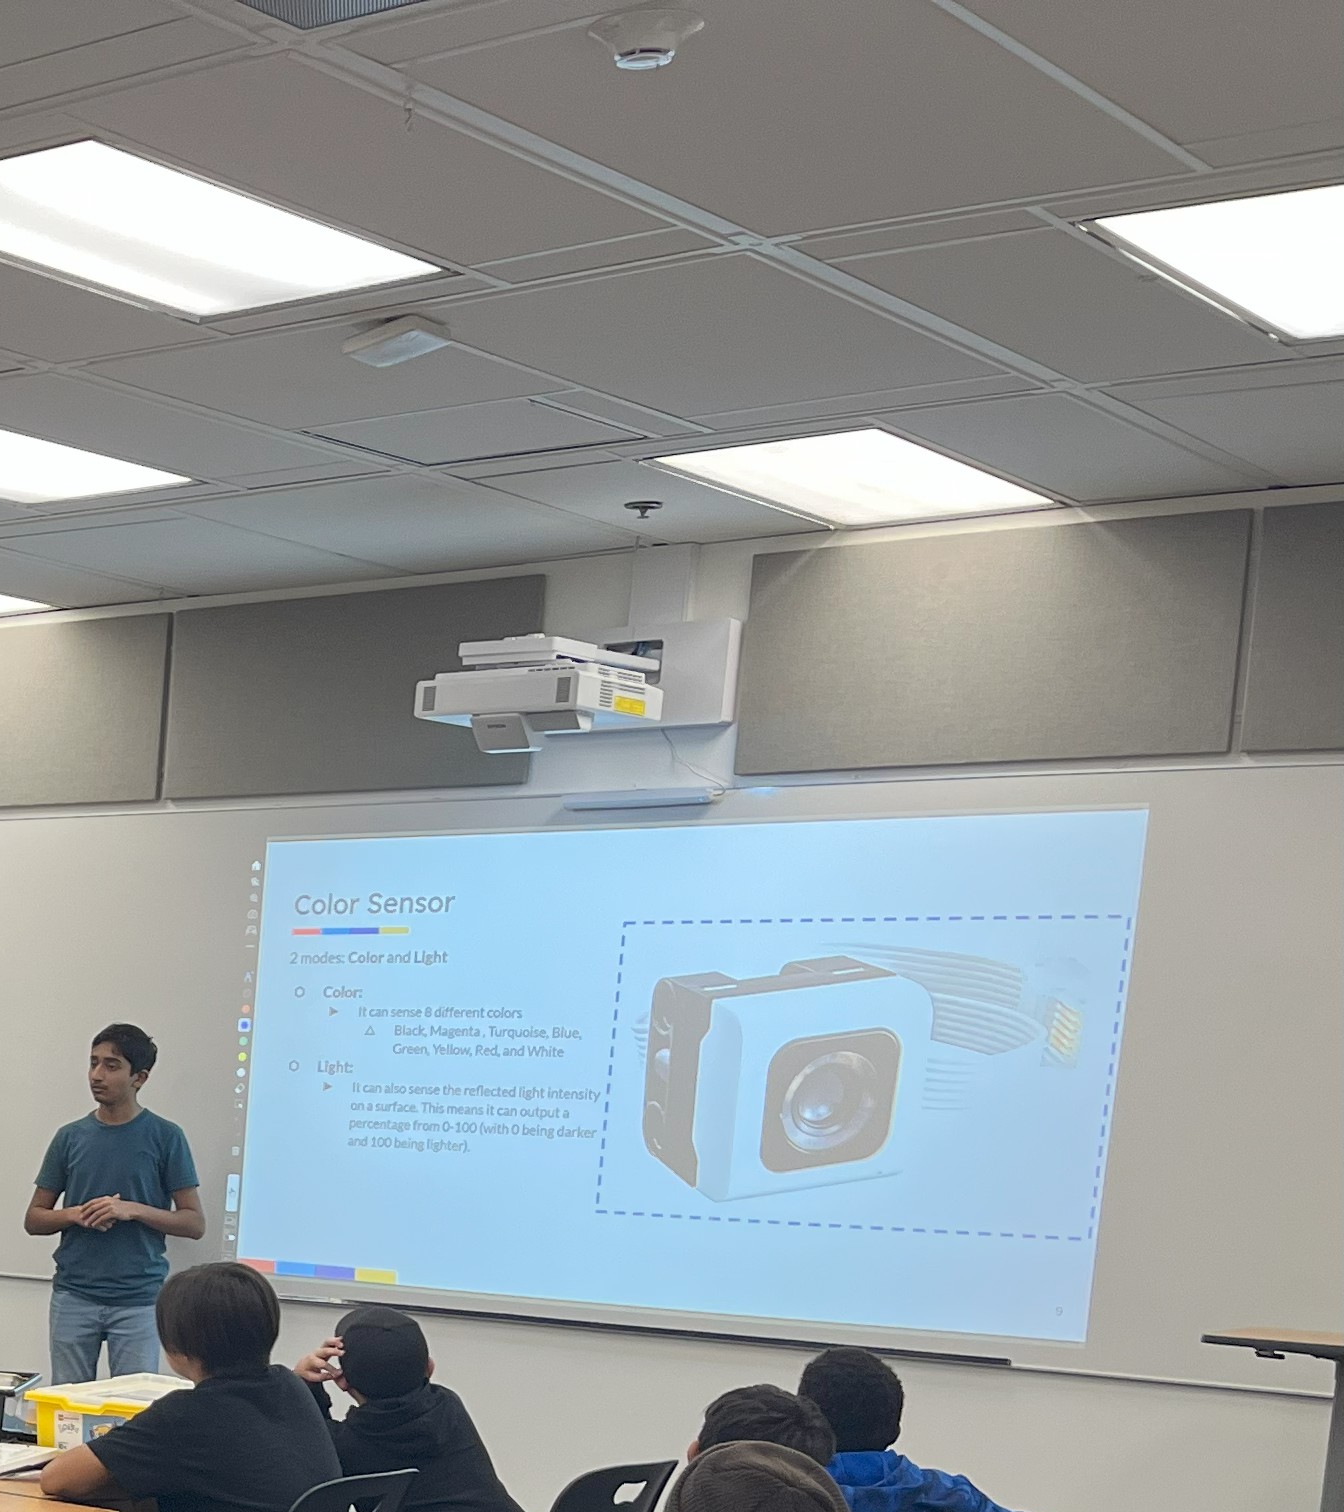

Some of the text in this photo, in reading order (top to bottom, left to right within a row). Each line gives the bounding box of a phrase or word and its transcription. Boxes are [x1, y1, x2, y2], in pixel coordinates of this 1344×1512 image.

[294, 892, 456, 915] Color Sensor
[289, 950, 449, 966] 2 modes: Color and Light
[323, 985, 363, 999] Color:
[358, 1006, 523, 1019] It can sense 8 different colors
[394, 1024, 428, 1037] Black,
[489, 1026, 550, 1039] Turquoise,
[552, 1026, 583, 1040] Blue,
[392, 1043, 565, 1058] Green, Yellow, Red, and White
[317, 1060, 353, 1075] Light:
[352, 1082, 601, 1103] It can also sense the reflected light intensity
[350, 1102, 365, 1111] on
[375, 1101, 418, 1113] surface.
[421, 1102, 444, 1114] This
[447, 1105, 484, 1116] means
[486, 1104, 495, 1116] it
[497, 1106, 517, 1117] can
[520, 1107, 560, 1120] output
[349, 1119, 598, 1139] percentage from 0-100 (with 0 being darker
[347, 1136, 470, 1154] and 100 being lighter).
